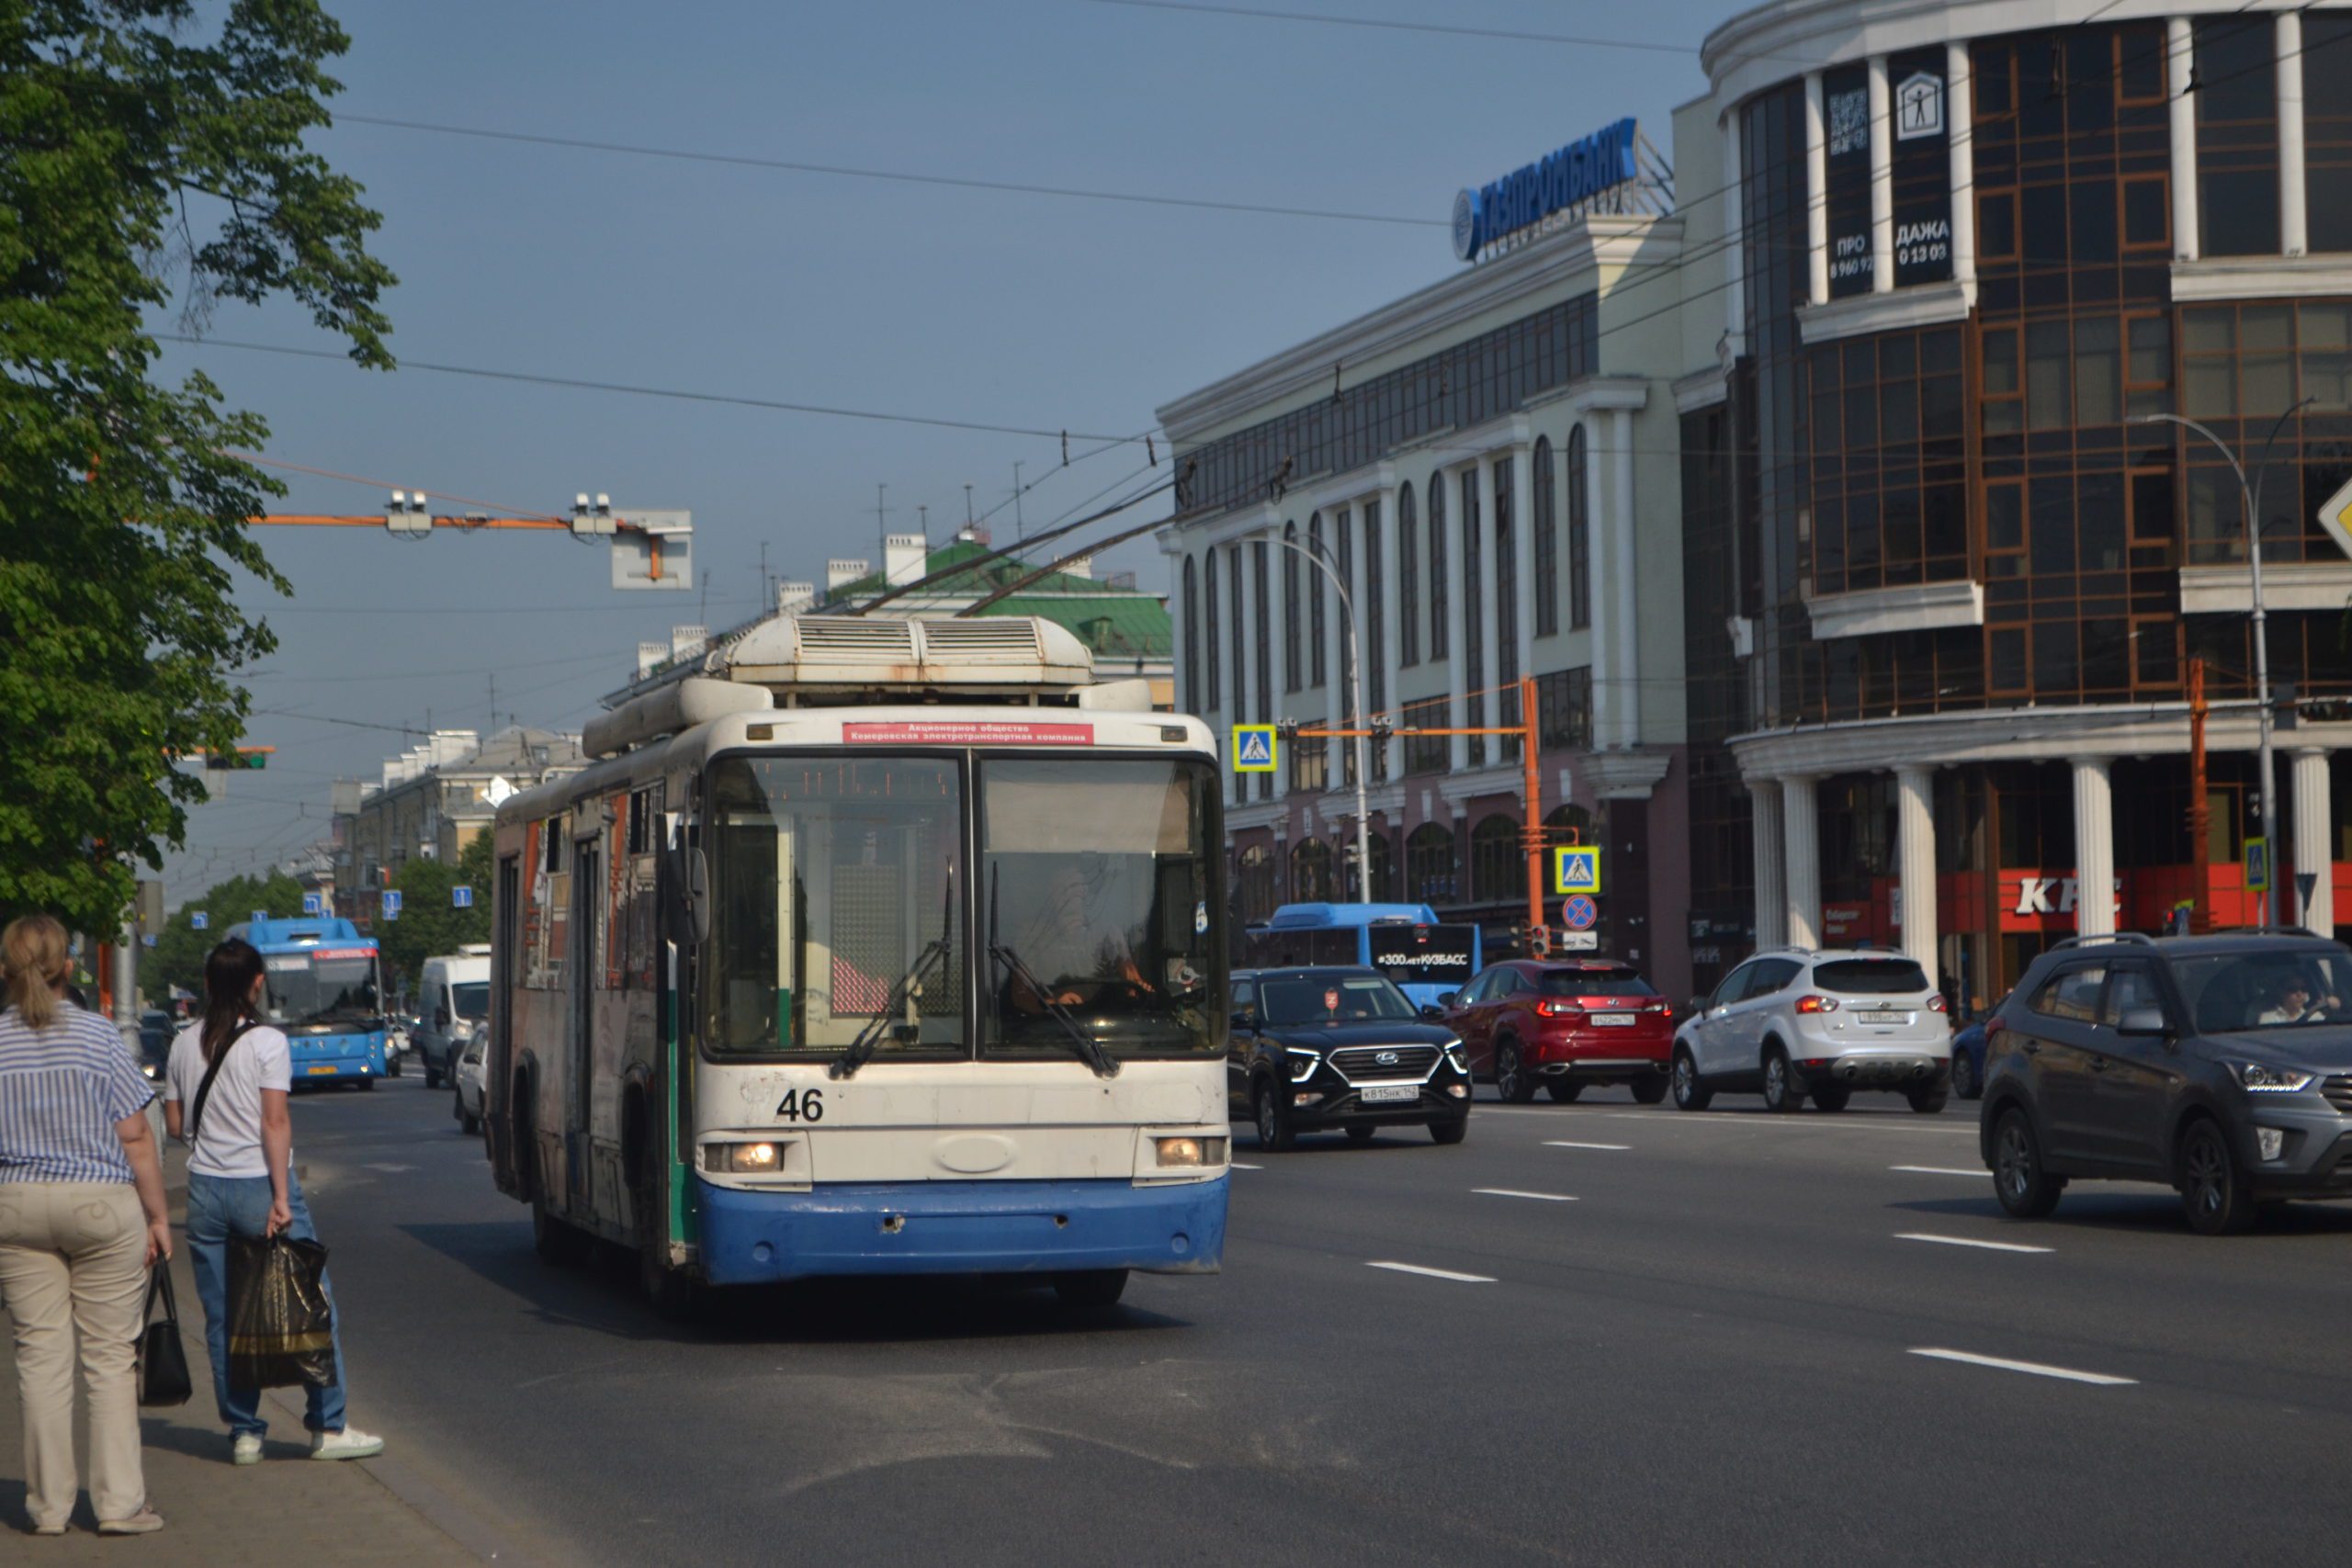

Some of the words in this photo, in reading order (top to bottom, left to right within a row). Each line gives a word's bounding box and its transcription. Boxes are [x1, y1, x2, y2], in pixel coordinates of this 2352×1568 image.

[1838, 235, 1865, 256] ПРО
[1896, 220, 1949, 246] ДАЖА
[1911, 245, 1928, 264] 13
[851, 732, 919, 741] Кемеровская
[923, 733, 1033, 741] электротранспортная
[909, 724, 977, 733] Акционерное
[980, 725, 1030, 733] общество
[776, 1089, 823, 1122] 46
